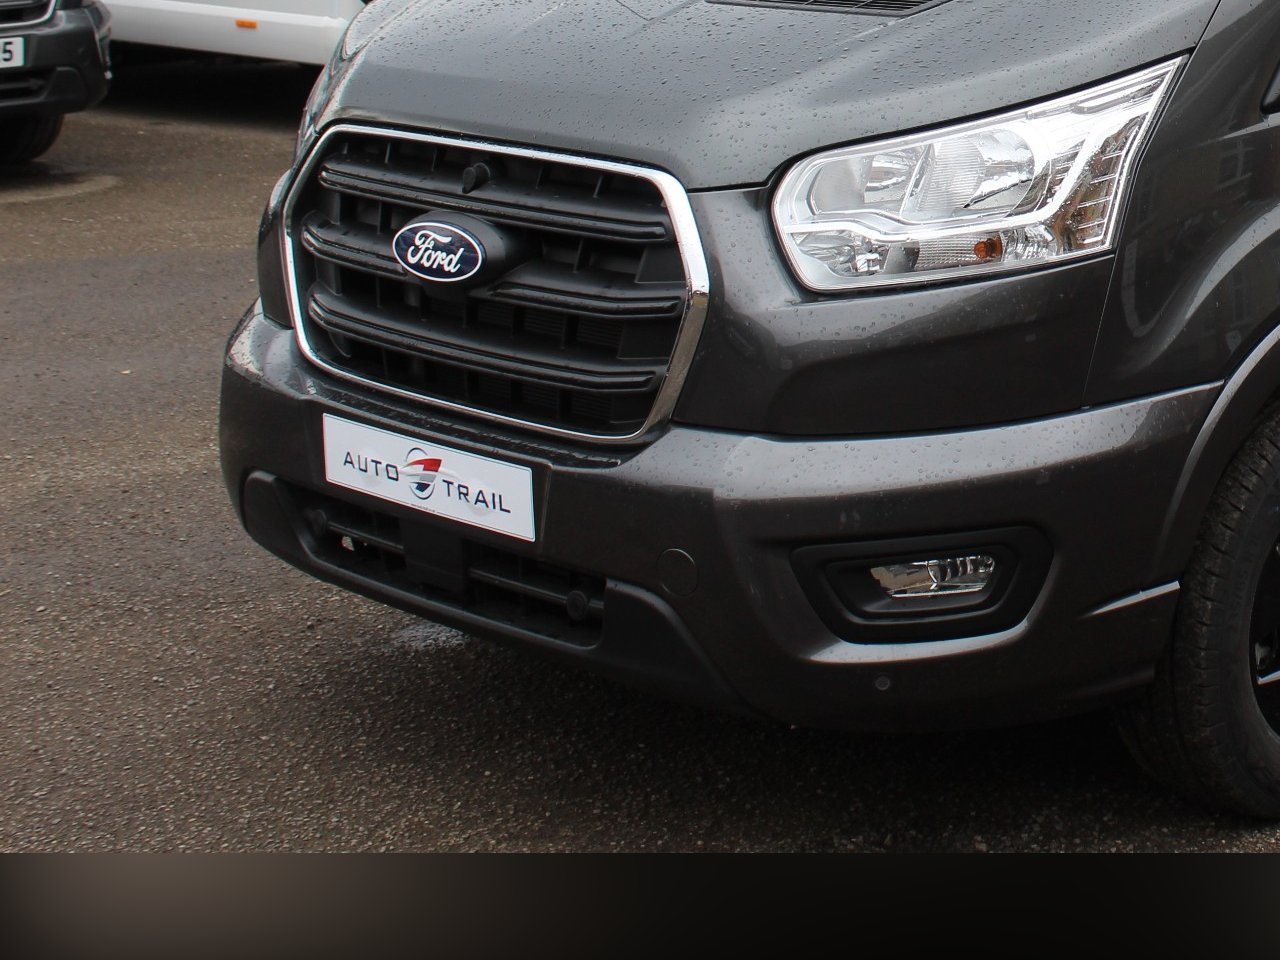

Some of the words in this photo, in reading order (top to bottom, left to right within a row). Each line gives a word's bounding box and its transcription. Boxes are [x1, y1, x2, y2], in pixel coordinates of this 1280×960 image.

[407, 230, 465, 273] Ford
[343, 451, 399, 482] AUTO
[442, 479, 512, 514] TRAIL
